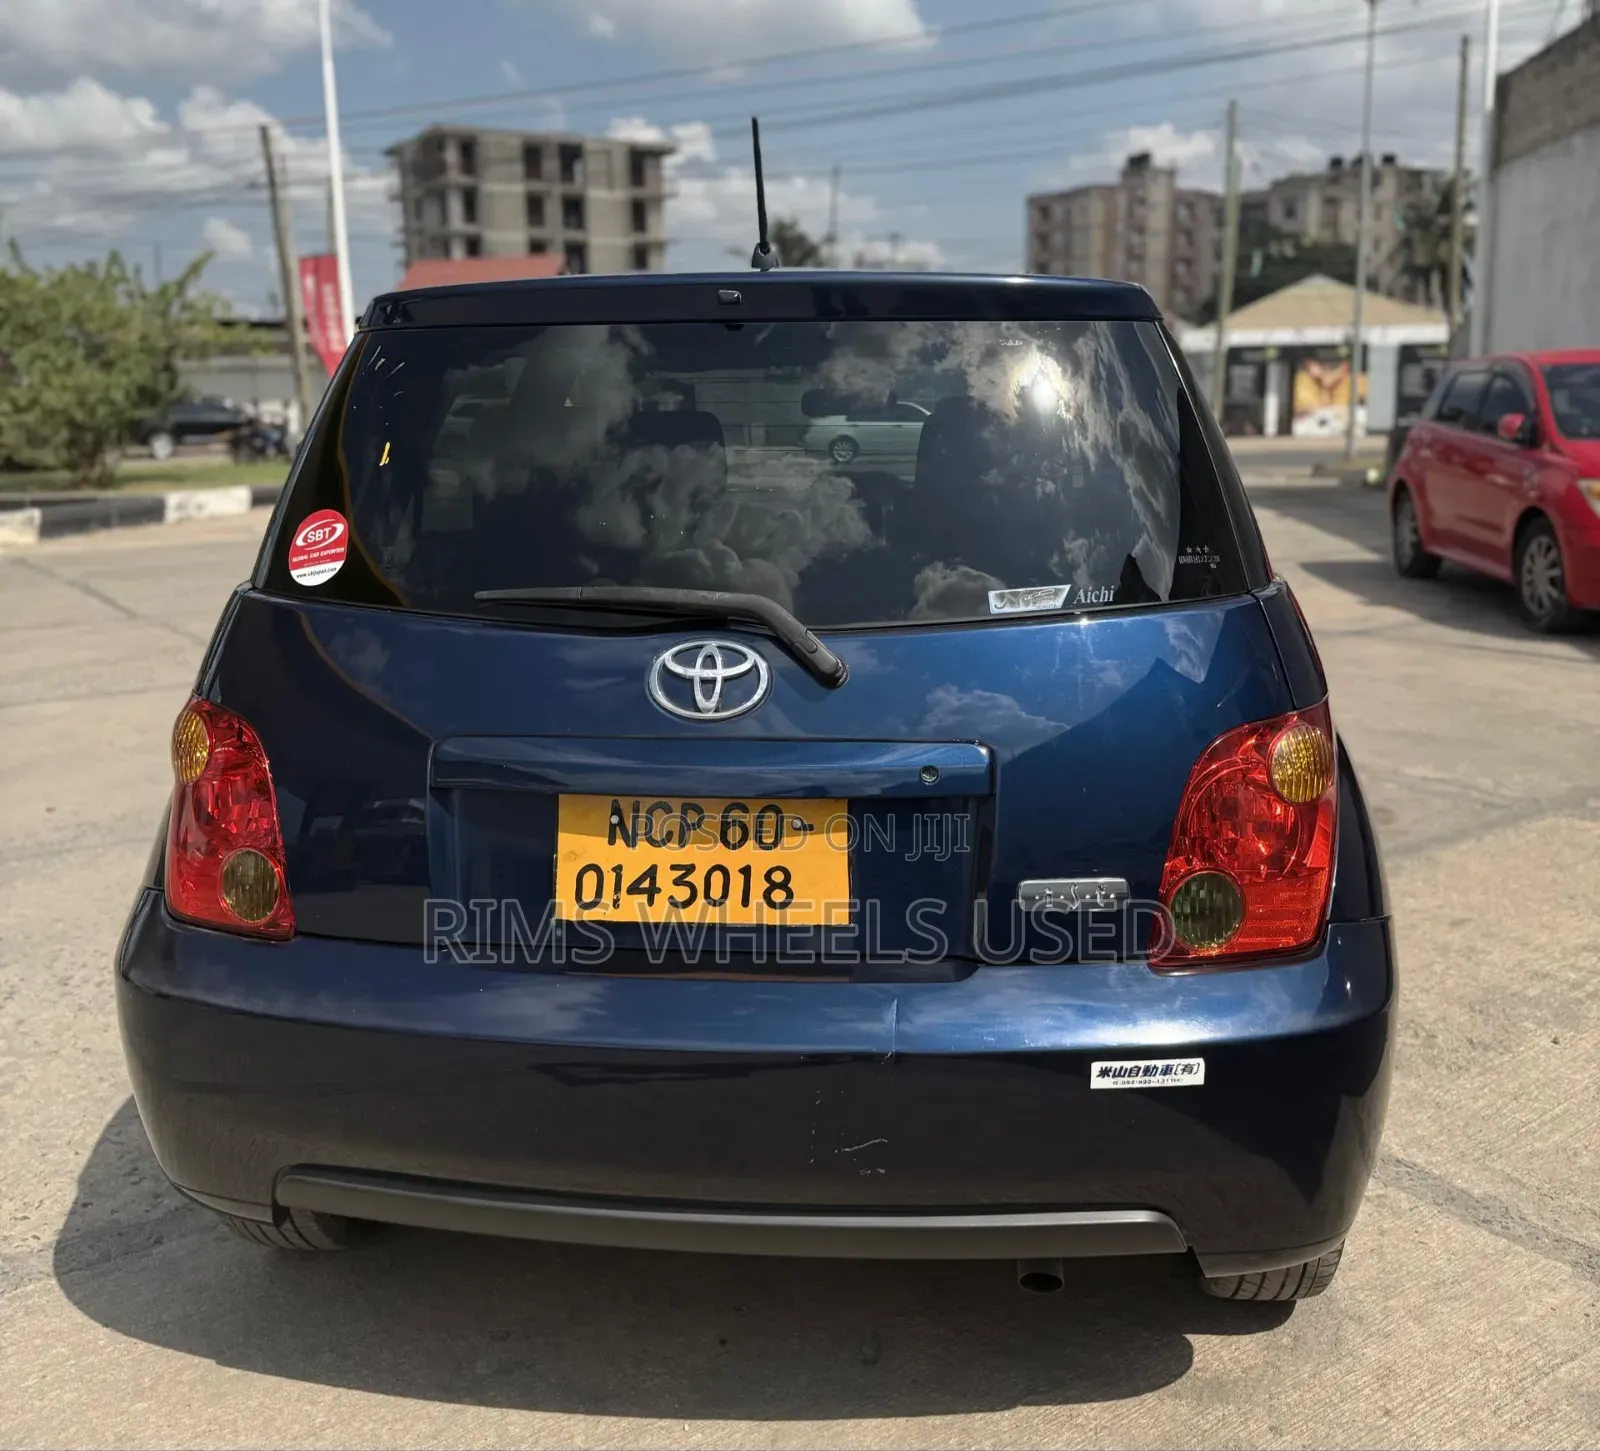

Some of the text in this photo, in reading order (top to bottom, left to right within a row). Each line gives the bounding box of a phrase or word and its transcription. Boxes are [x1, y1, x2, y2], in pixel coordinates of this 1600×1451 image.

[307, 527, 332, 543] SBT
[292, 554, 309, 563] GLOBAL
[310, 551, 320, 559] CAR
[320, 547, 345, 557] EXPORTER
[1073, 585, 1115, 604] Aichi
[574, 863, 795, 911] 0143018
